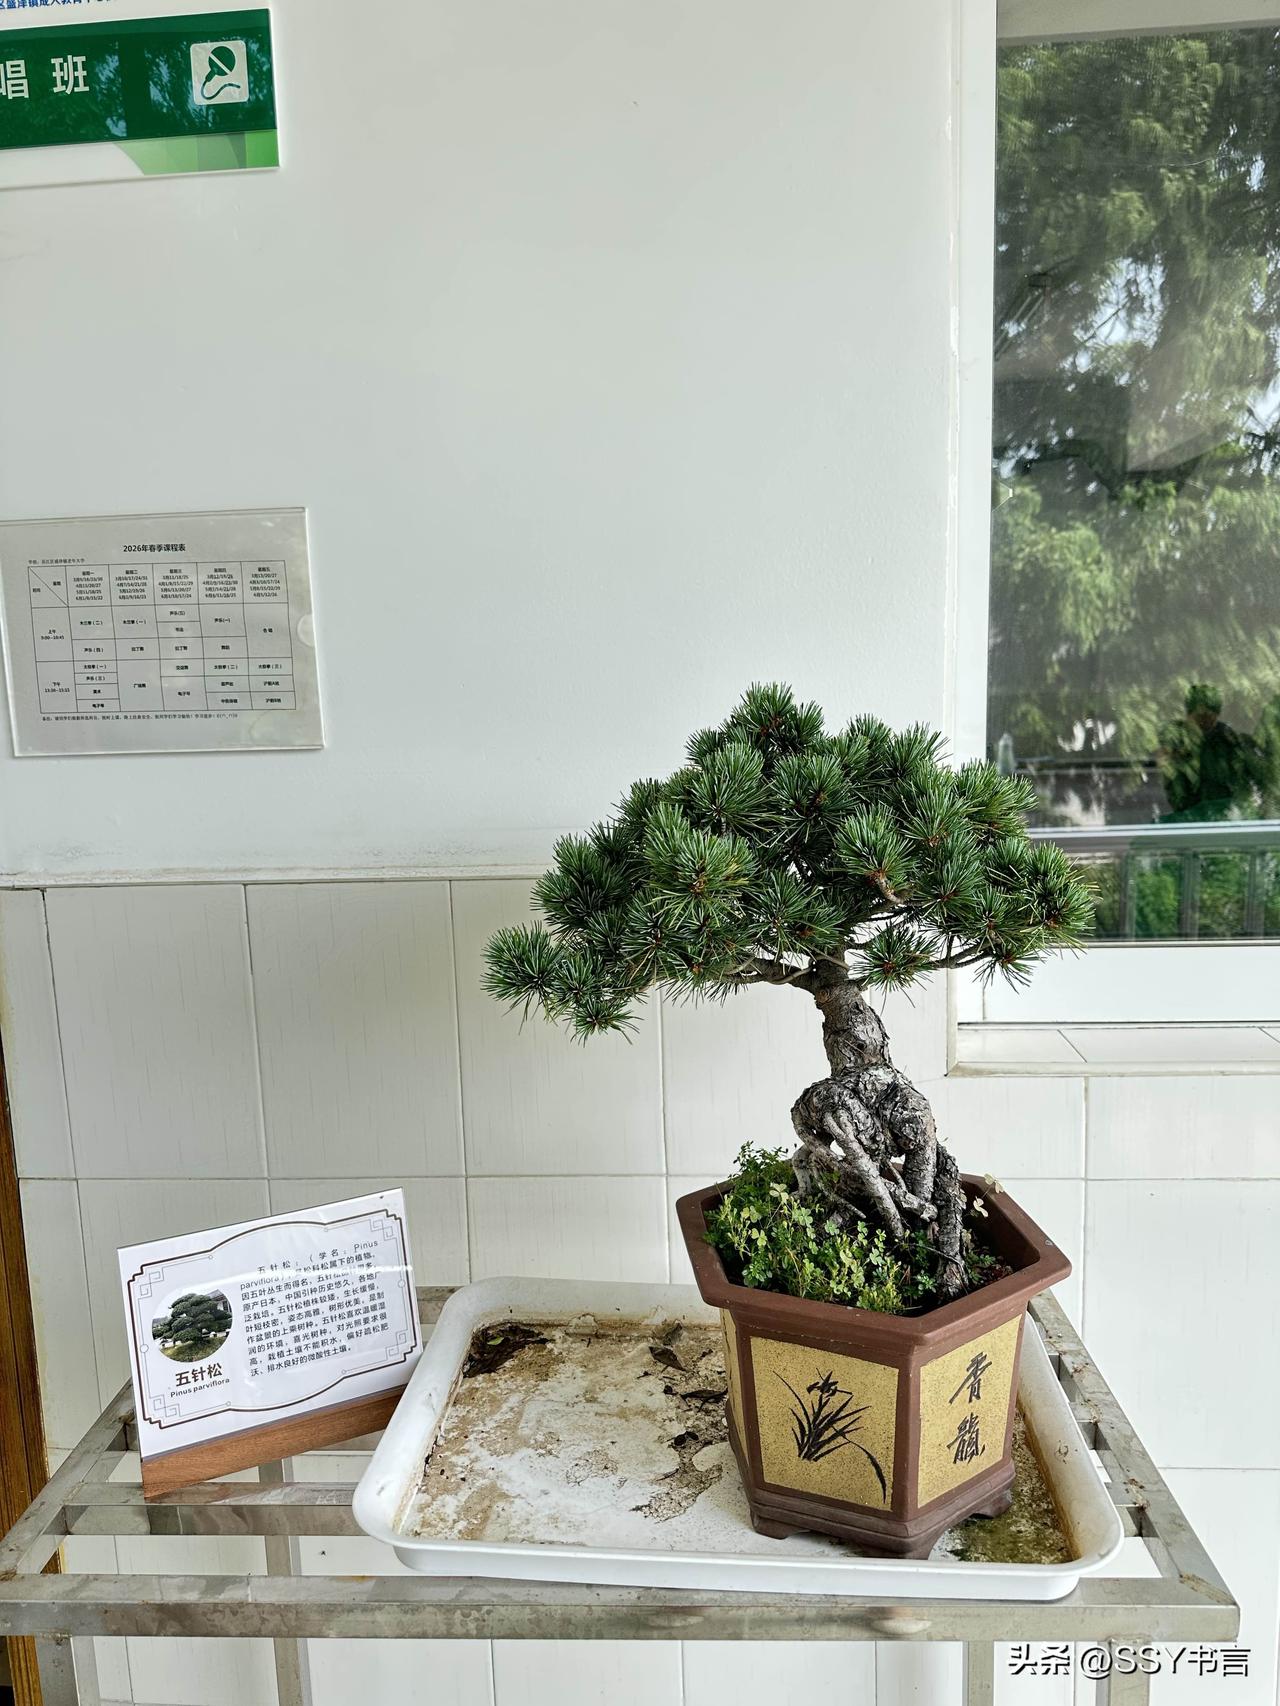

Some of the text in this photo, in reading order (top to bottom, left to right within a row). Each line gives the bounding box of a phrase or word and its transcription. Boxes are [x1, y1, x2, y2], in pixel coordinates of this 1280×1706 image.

[123, 544, 186, 552] 2026年春季课程表
[353, 1240, 379, 1253] Pinus
[175, 1362, 222, 1387] 五针松
[170, 1377, 230, 1398] Pinus parviflora
